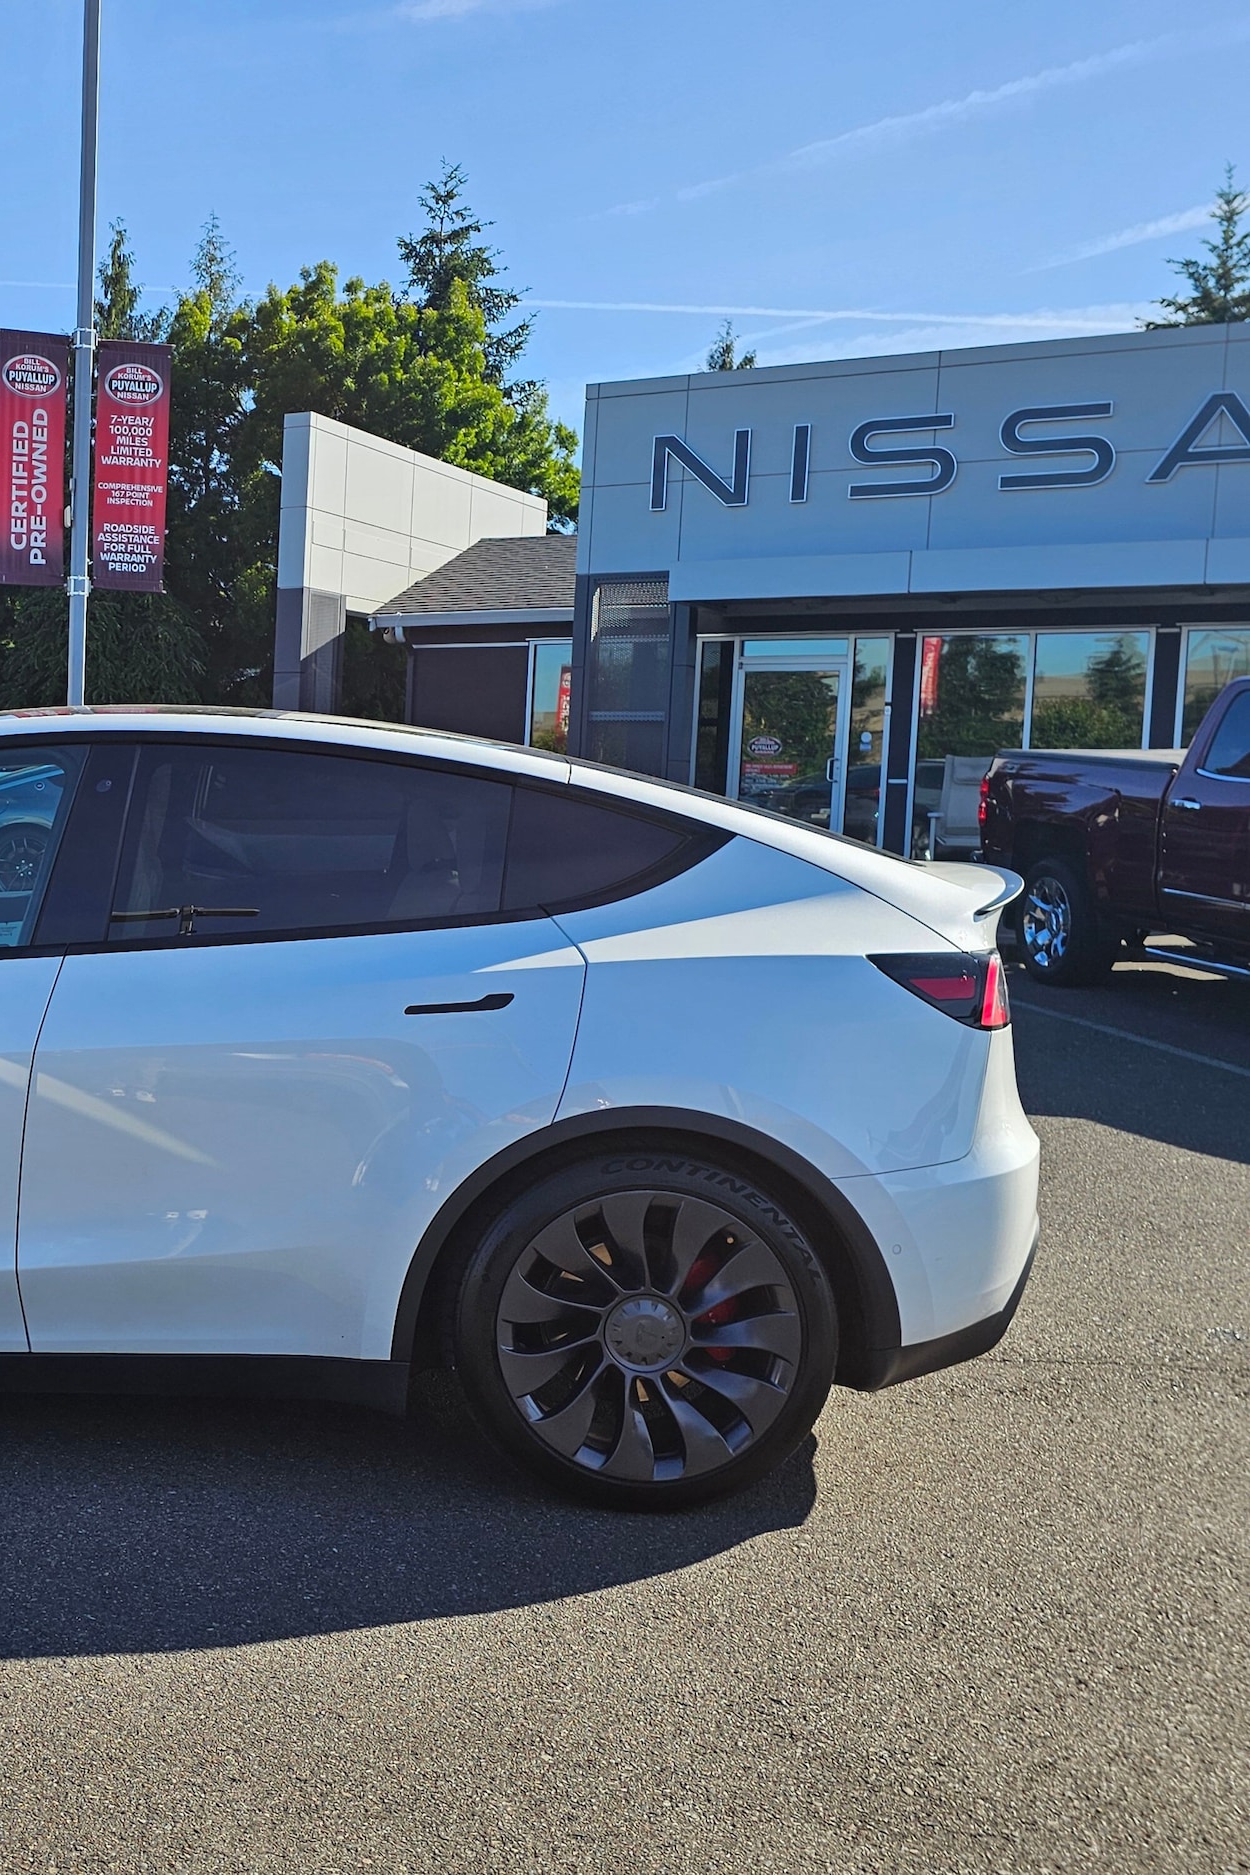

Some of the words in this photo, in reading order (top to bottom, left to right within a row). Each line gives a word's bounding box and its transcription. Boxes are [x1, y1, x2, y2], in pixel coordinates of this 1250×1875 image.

[15, 363, 50, 373] KORUM'S
[23, 358, 41, 366] BILL
[126, 367, 143, 375] BILL
[9, 370, 55, 385] PUYALLUP
[117, 373, 152, 382] KORUM'S
[15, 382, 47, 392] NISSAN
[111, 380, 158, 393] PUYALLUP
[117, 391, 149, 401] NISSAN
[110, 415, 155, 427] 7-YEAR/
[109, 425, 153, 437] 100,000
[116, 435, 149, 447] MILES
[110, 445, 153, 457] LIMITED
[101, 456, 162, 469] WARRANTY
[10, 420, 29, 551] CERTIFIED
[29, 408, 48, 565] PRE-OWNED
[98, 482, 163, 493] COMPREHENSIVE
[111, 490, 125, 498] 167
[126, 491, 150, 499] POINT
[106, 497, 153, 507] INSPECTION
[103, 523, 156, 535] ROADSIDE
[97, 532, 160, 545] ASSISTANCE
[103, 543, 126, 552] FOR
[127, 544, 152, 554] FULL
[100, 552, 158, 564] WARRANTY
[108, 562, 147, 573] PERIOD
[601, 1157, 824, 1284] CONTINENTAL
